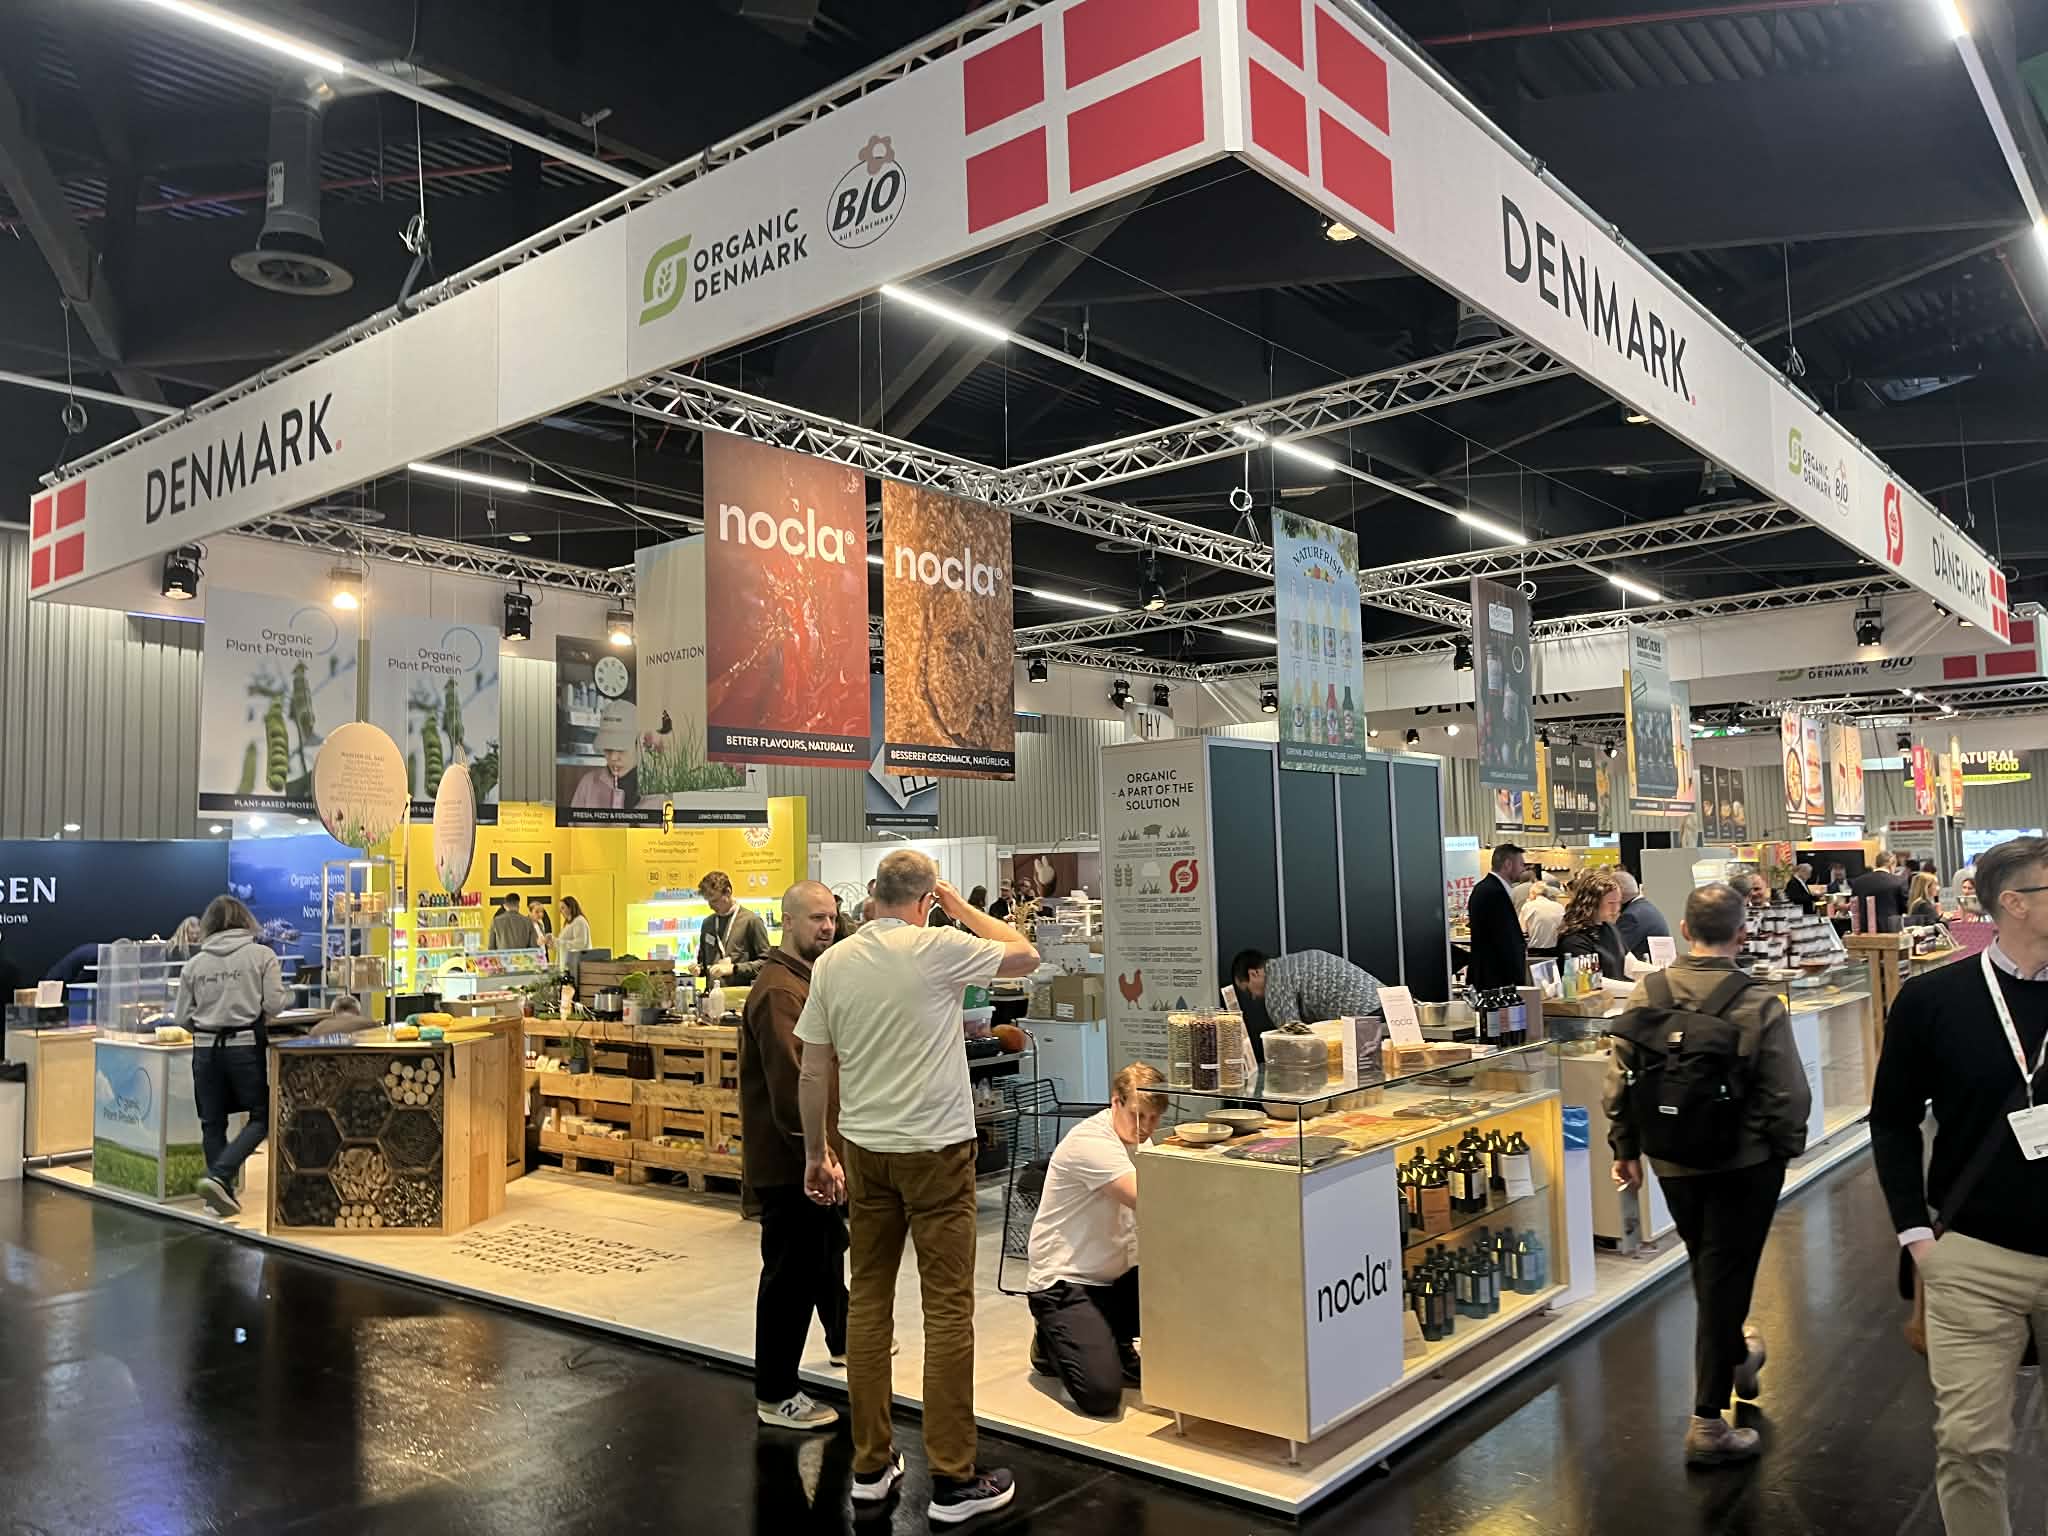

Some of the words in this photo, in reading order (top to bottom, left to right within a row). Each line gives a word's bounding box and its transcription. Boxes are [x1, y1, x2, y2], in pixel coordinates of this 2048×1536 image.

[831, 169, 900, 231] BIO
[693, 208, 799, 273] ORGANIC
[694, 233, 808, 303] DENMARK
[1802, 450, 1829, 480] ORGANIC
[1804, 467, 1832, 498] DENMARK
[1835, 478, 1849, 503] BIO
[1932, 533, 1989, 610] DÄNEMARK
[261, 628, 313, 645] Organic
[226, 639, 262, 655] Plant
[266, 644, 313, 660] Protein
[418, 648, 462, 664] Organic
[646, 645, 705, 666] INNOVATION
[388, 658, 418, 672] Plant
[421, 662, 462, 676] Protein
[1808, 666, 1869, 680] DENMARK
[726, 735, 759, 747] BETTER
[760, 737, 808, 751] FLAVOURS,
[808, 741, 856, 753] NATURALLY.
[890, 750, 927, 762] BESSERER
[927, 754, 972, 766] GESCHMACK,
[973, 755, 1011, 767] NATÜRLICH.
[1960, 749, 2019, 764] ATURAL
[1988, 762, 2019, 773] FOOD
[1126, 770, 1177, 784] ORGANIC
[1118, 788, 1125, 798] A
[1128, 786, 1153, 797] PART
[1155, 784, 1171, 795] OF
[1174, 782, 1194, 793] THE
[234, 800, 285, 809] PLANT-BASED
[286, 801, 316, 809] PROTEI
[1126, 797, 1180, 811] SOLUTION
[290, 873, 320, 888] Organic
